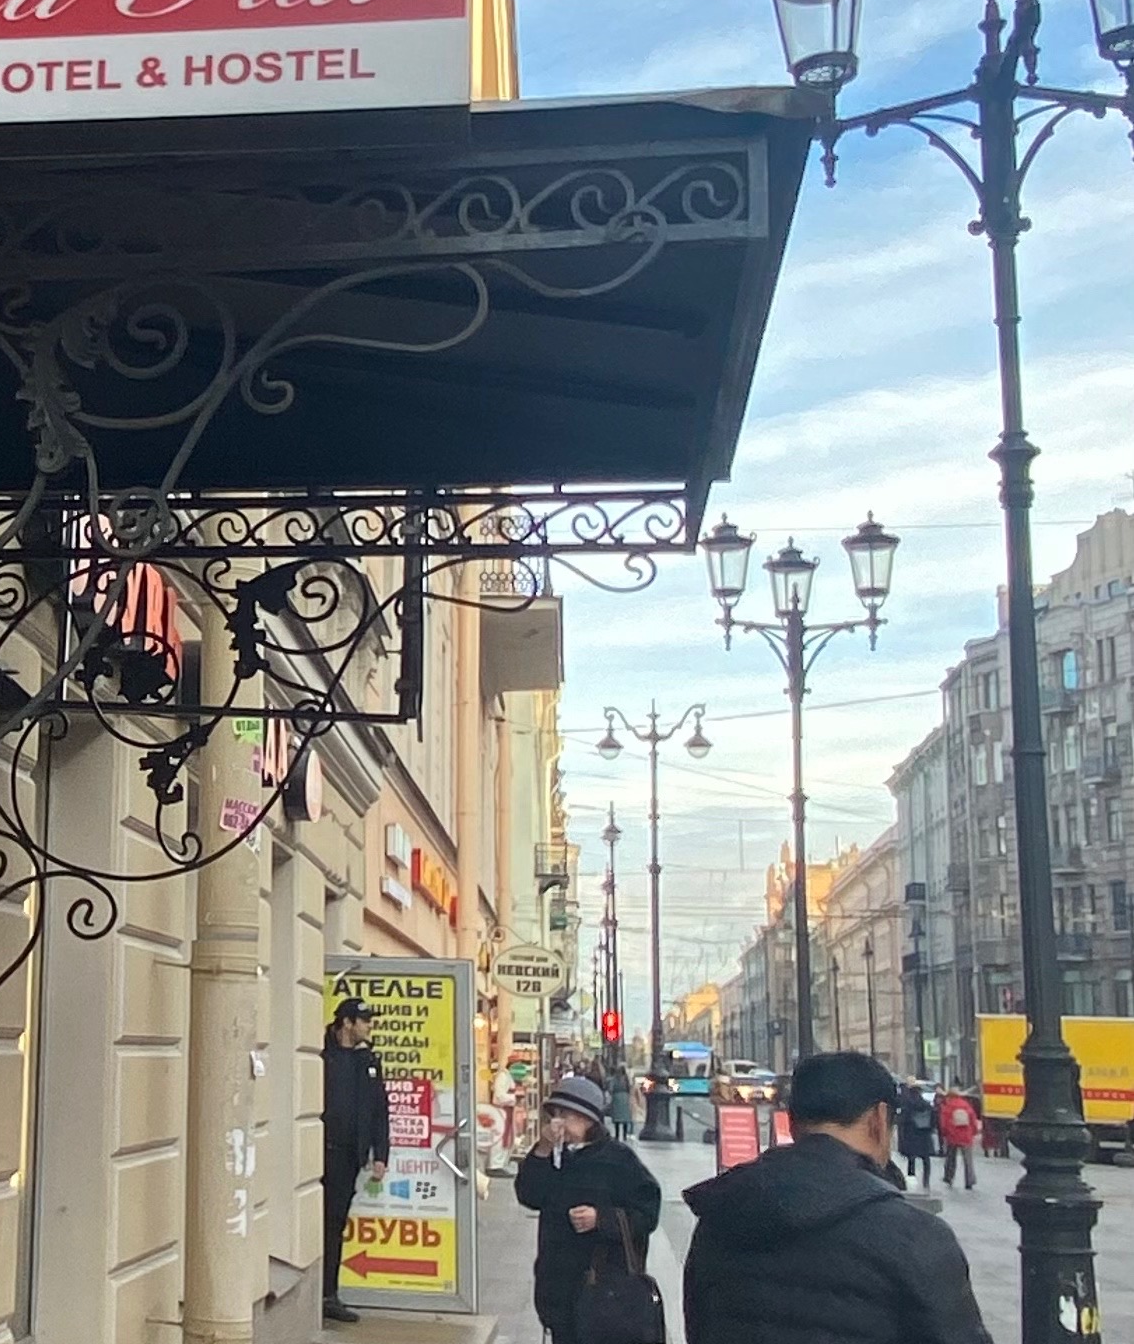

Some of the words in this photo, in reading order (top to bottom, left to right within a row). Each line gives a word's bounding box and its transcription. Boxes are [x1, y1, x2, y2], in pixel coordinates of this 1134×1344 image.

[137, 56, 167, 87] &
[185, 48, 376, 86] HOSTEL
[498, 964, 559, 978] НЕВСКИЙ
[333, 978, 443, 999] АТЕЛЬЕ
[516, 980, 541, 992] 128
[371, 1004, 412, 1016] ШИВ
[416, 1005, 429, 1017] И
[372, 1020, 425, 1033] МОНТ
[371, 1035, 429, 1048] ЕЖДЫ
[383, 1067, 443, 1081] НОСТИ
[396, 1158, 439, 1175] ЦЕНТР
